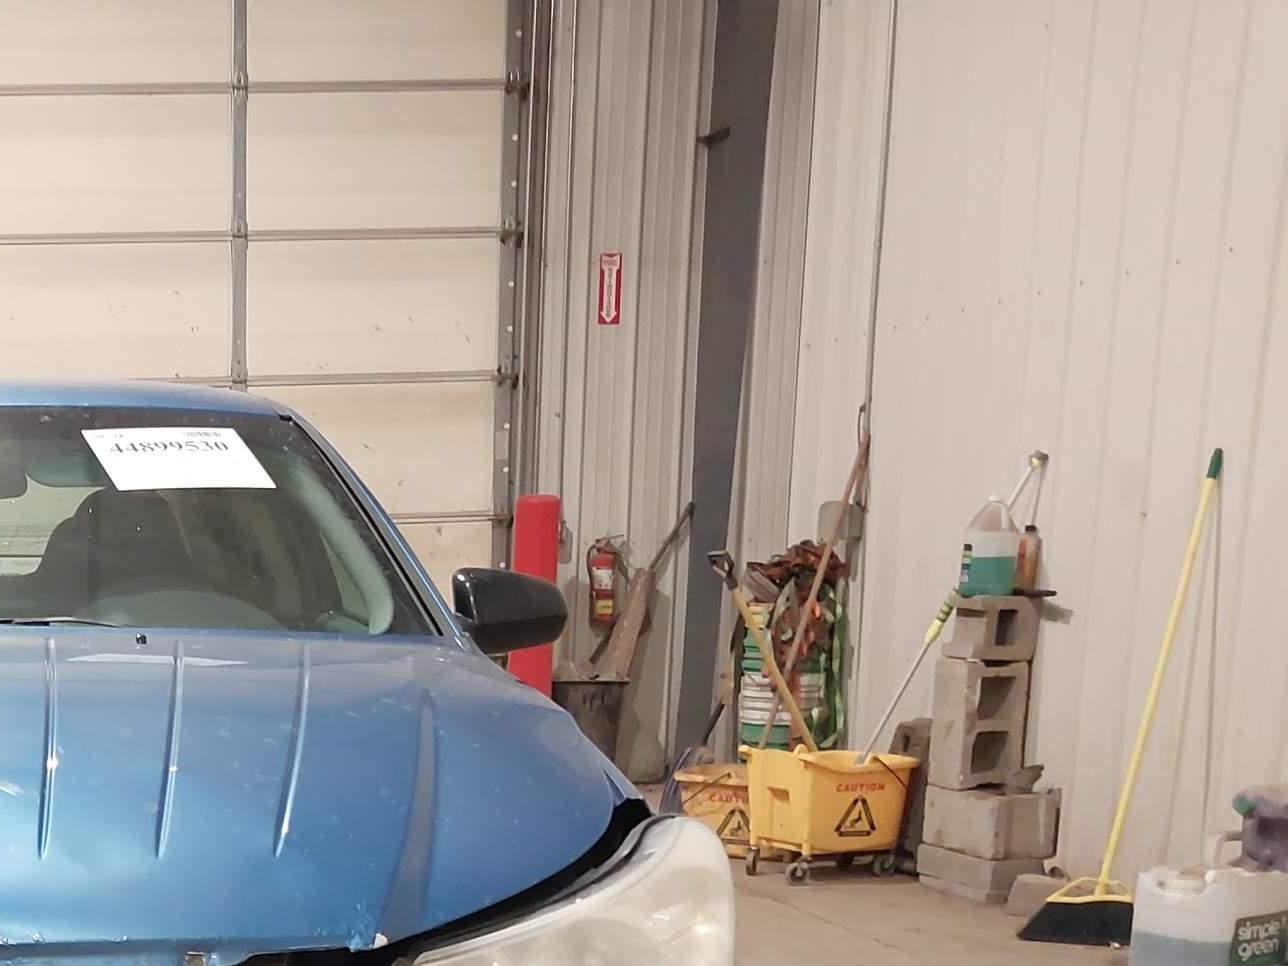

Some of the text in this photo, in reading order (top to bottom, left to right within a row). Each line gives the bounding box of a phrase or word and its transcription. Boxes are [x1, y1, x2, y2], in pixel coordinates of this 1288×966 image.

[111, 440, 229, 454] 44899530
[836, 783, 885, 792] CAUTION
[1238, 921, 1280, 940] simple
[1238, 939, 1279, 961] green
